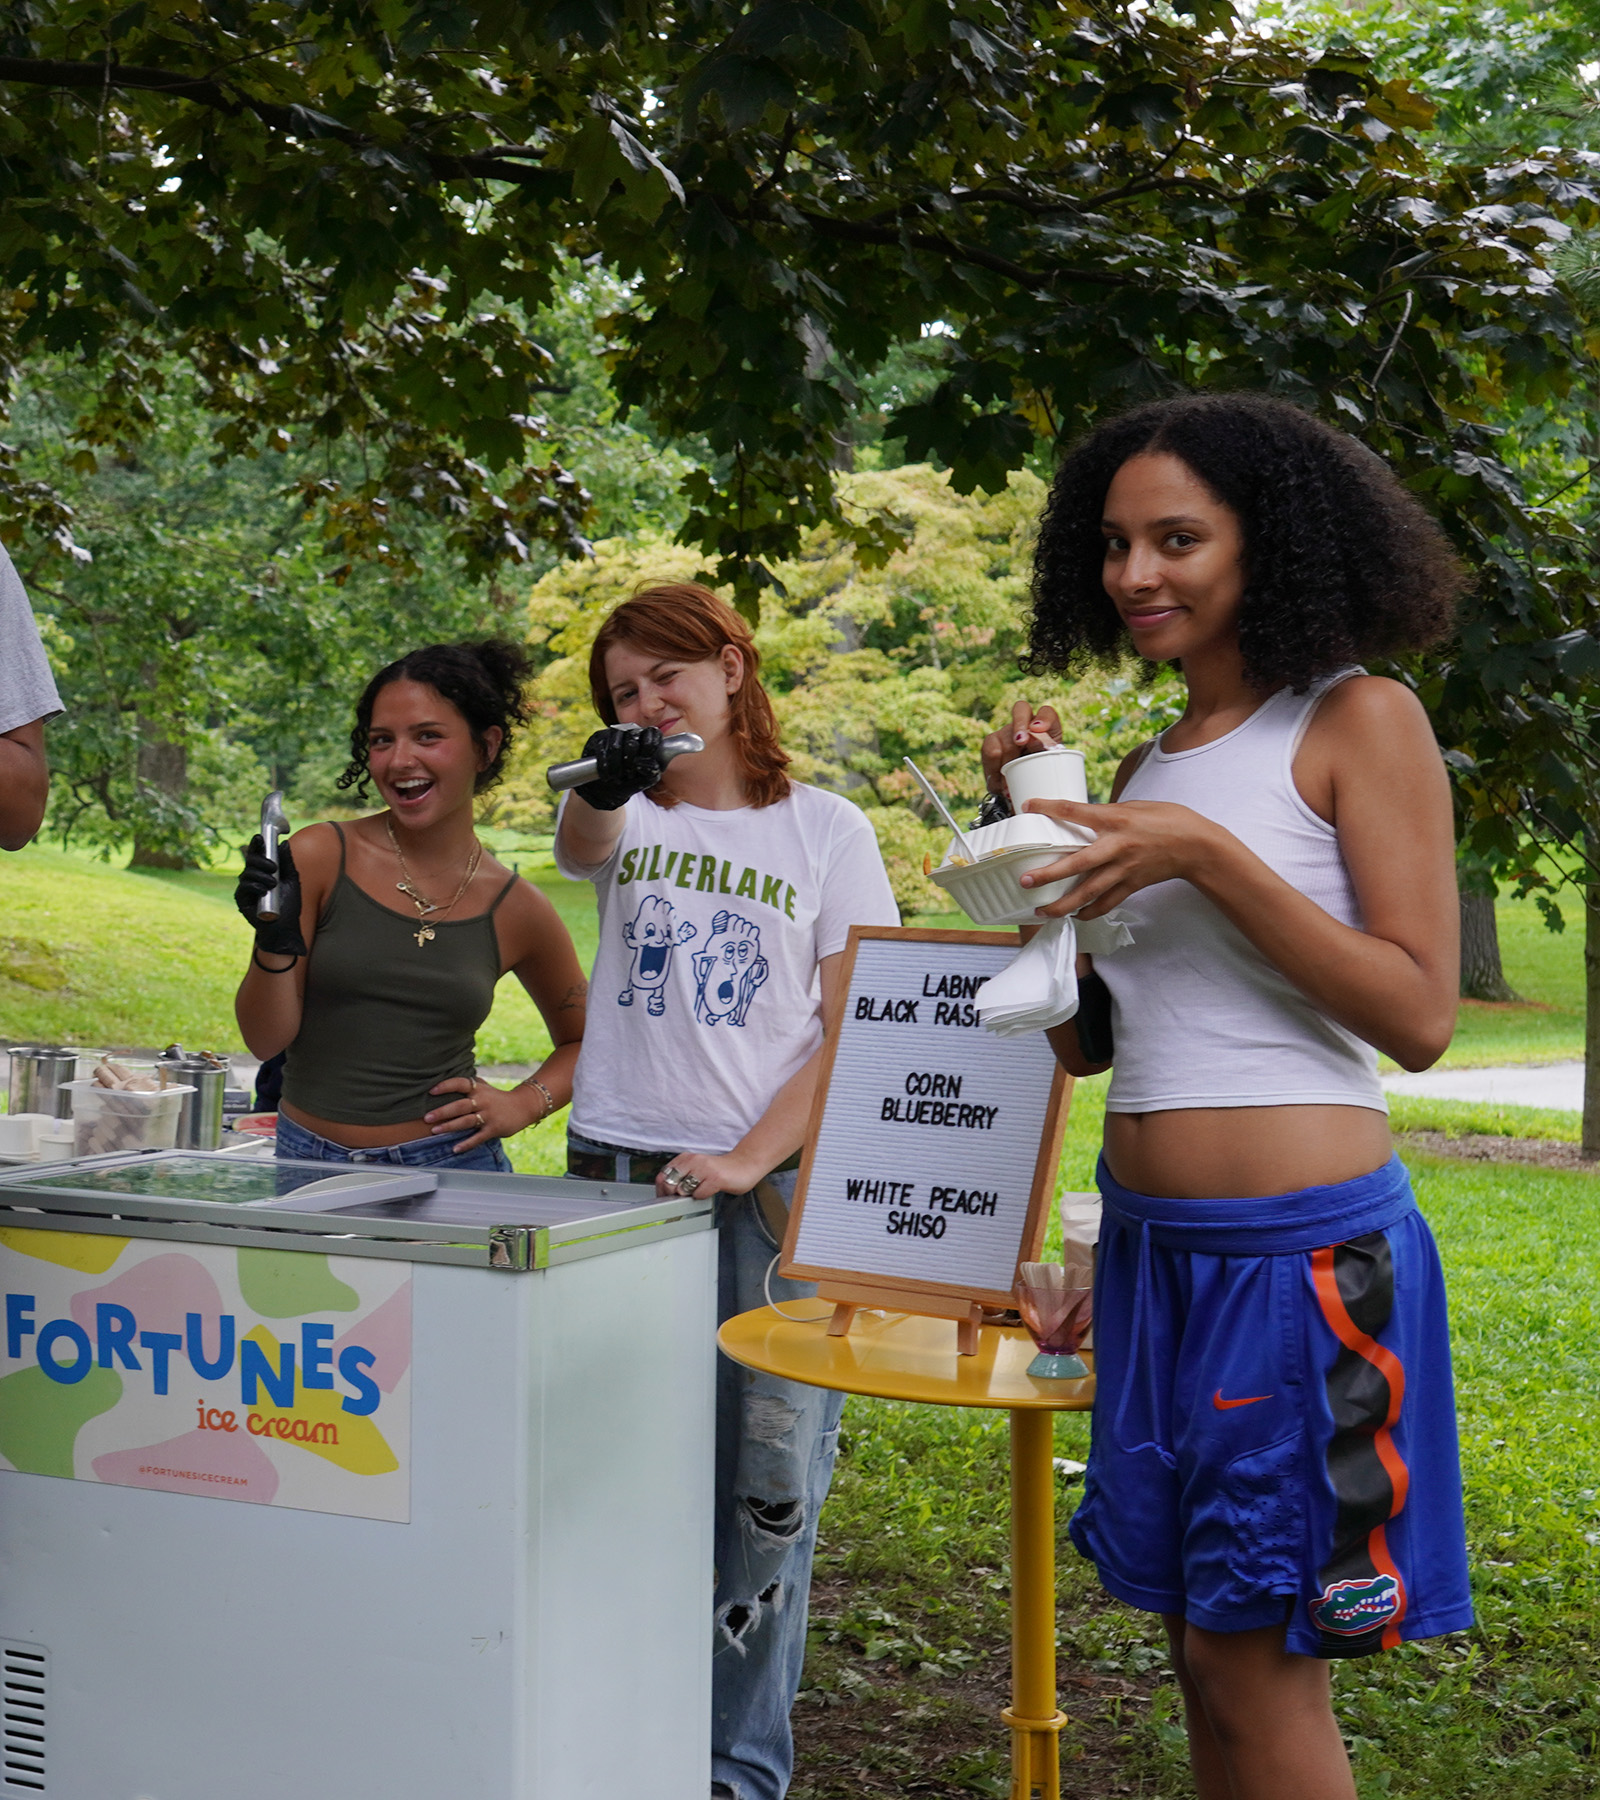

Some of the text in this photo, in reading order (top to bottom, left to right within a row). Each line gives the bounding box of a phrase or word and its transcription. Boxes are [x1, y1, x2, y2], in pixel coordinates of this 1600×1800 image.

[617, 844, 797, 922] SILVERLAKE
[854, 996, 920, 1024] BLACK
[904, 1071, 963, 1099] CORN
[880, 1098, 999, 1130] BLUEBERRY
[846, 1178, 998, 1217] WHITE PEACH
[886, 1211, 947, 1240] SHISO
[5, 1293, 381, 1417] FORTUNES
[197, 1399, 340, 1446] ice cream
[138, 1465, 249, 1486] @FORTUNESICECREAM
